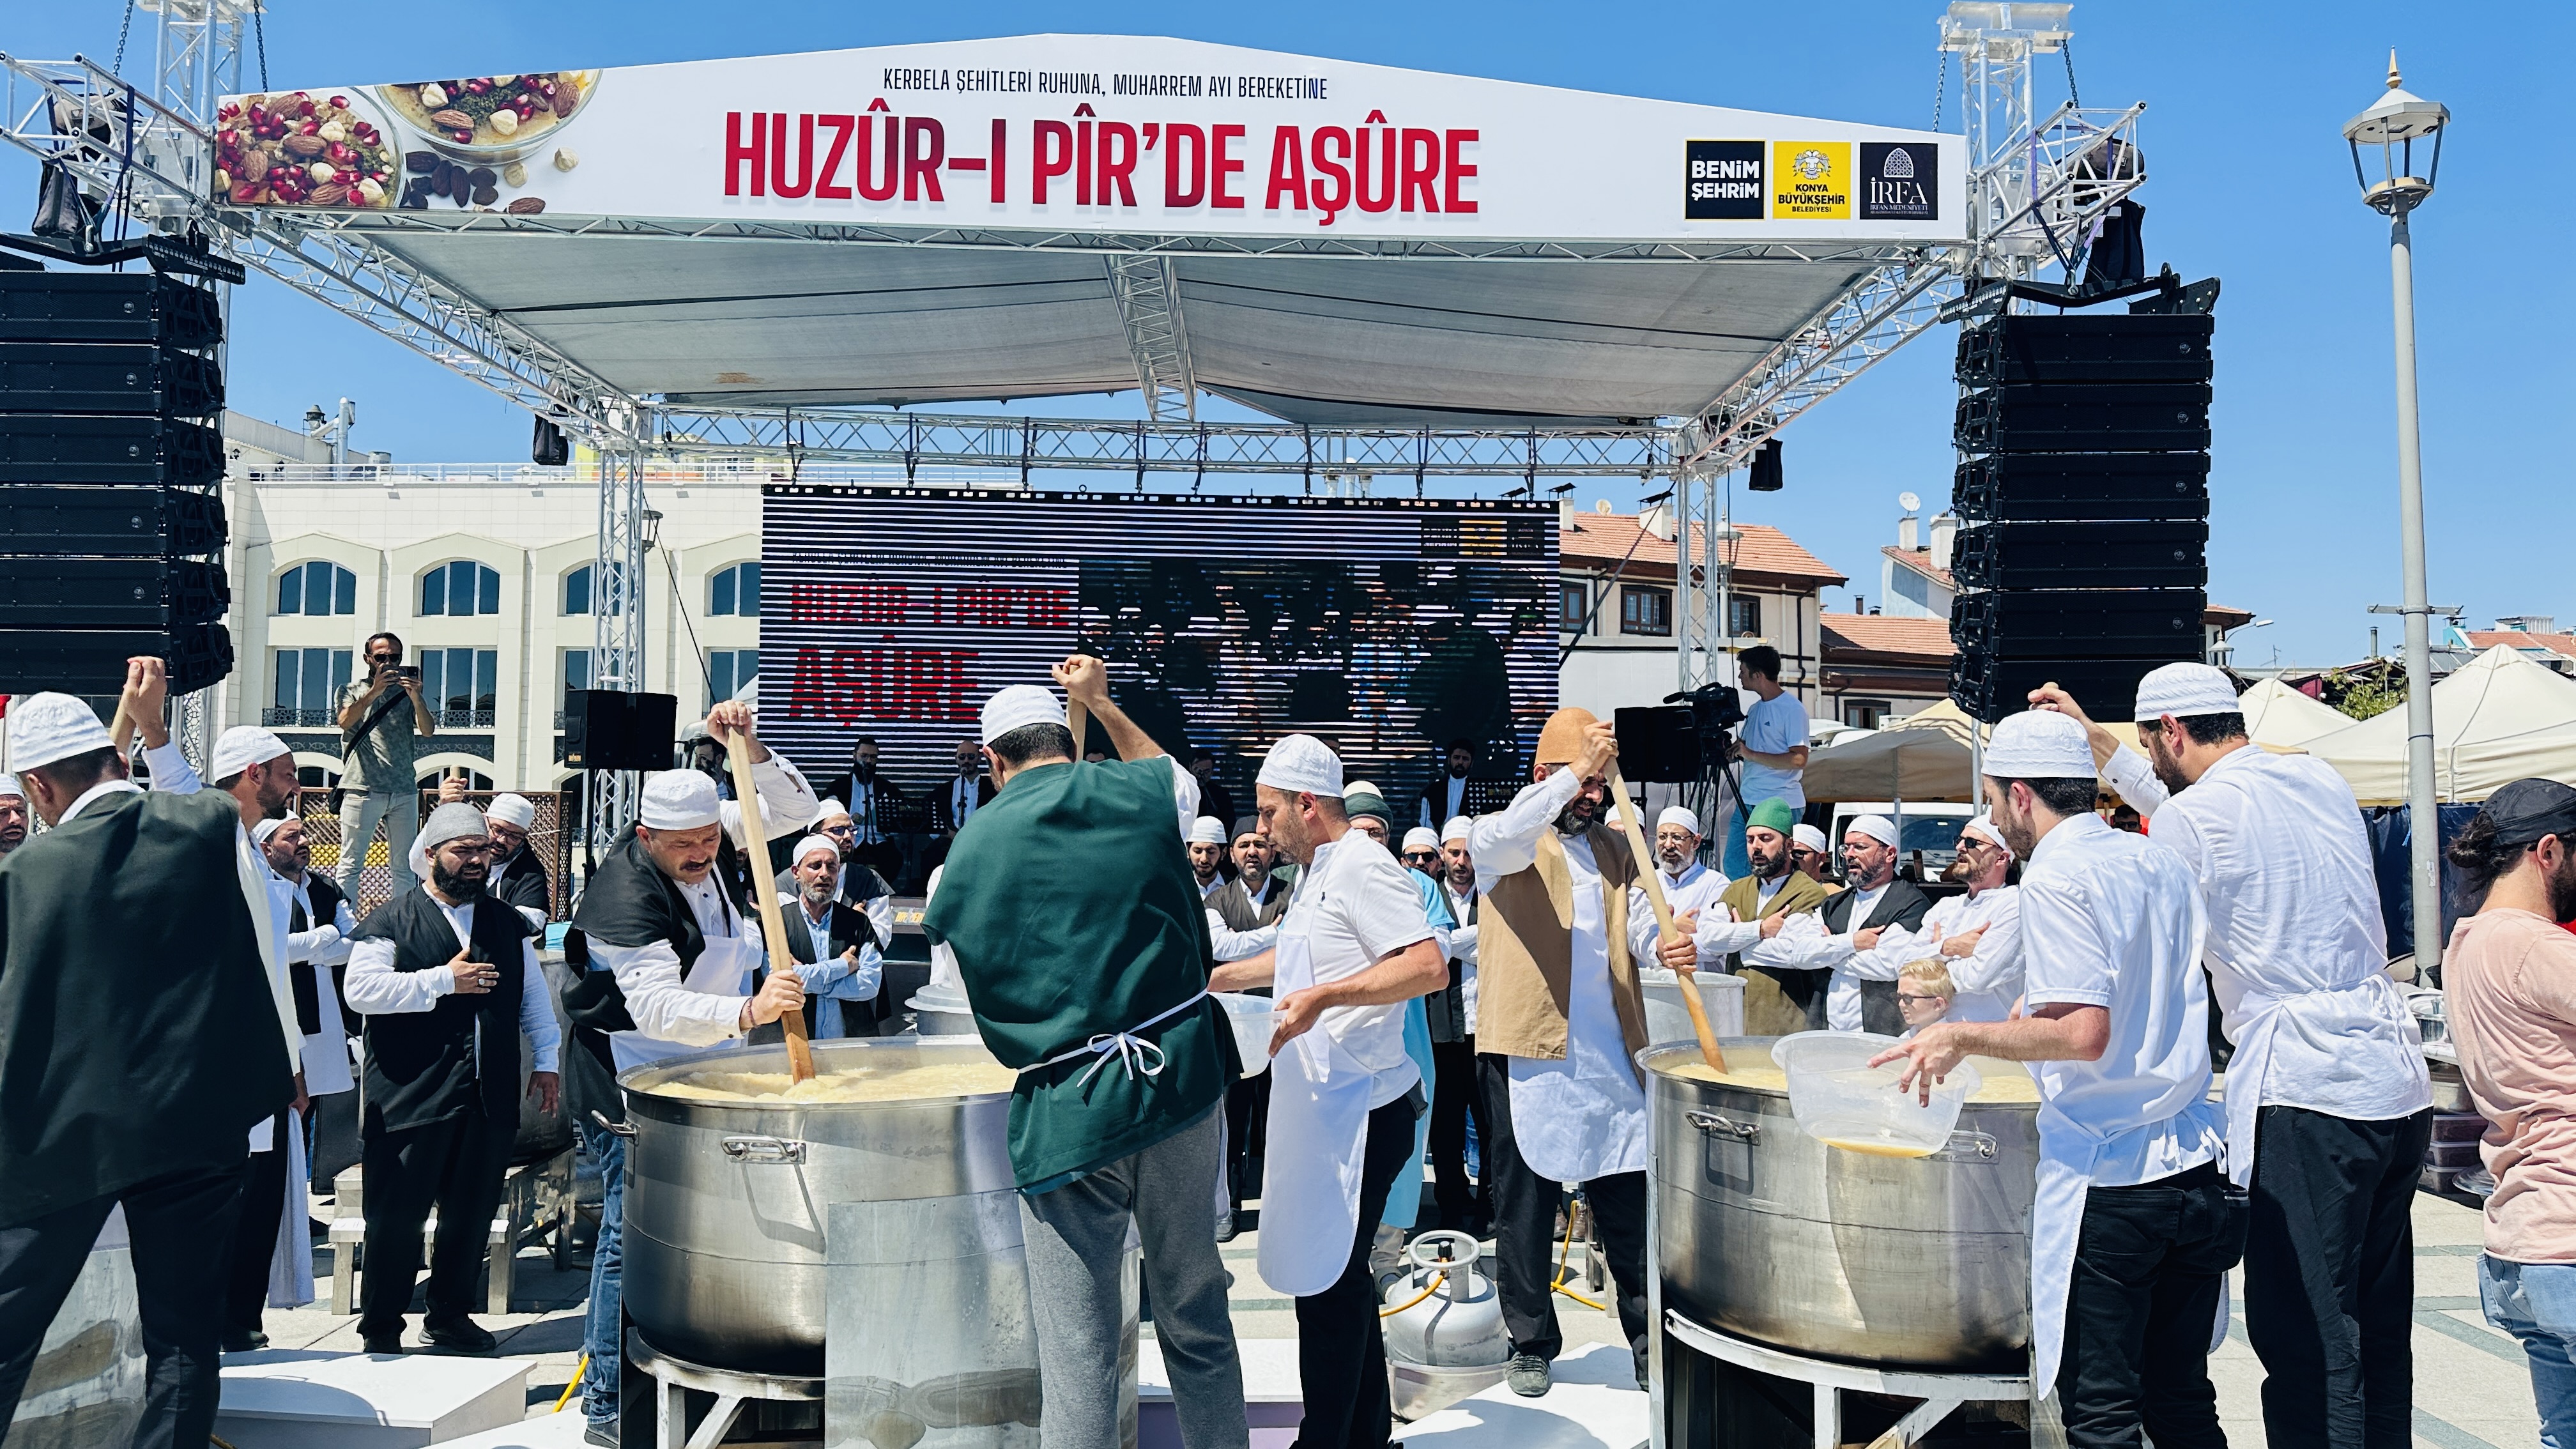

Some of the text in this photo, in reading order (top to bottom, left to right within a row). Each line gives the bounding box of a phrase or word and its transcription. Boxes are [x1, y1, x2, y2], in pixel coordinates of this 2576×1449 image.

[884, 67, 1328, 100] KERBELA ŞEHİTLERİ RUHUNA, MUHARREM AYI BEREKETİNE
[1032, 103, 1246, 209] PÎR'DE
[1265, 109, 1479, 226] AŞÛRE
[1691, 182, 1759, 201] ŞEHRİM
[1778, 192, 1845, 206] BÜYÜKŞEHİR
[1795, 183, 1828, 192] KONYA
[1870, 176, 1928, 204] İRFA
